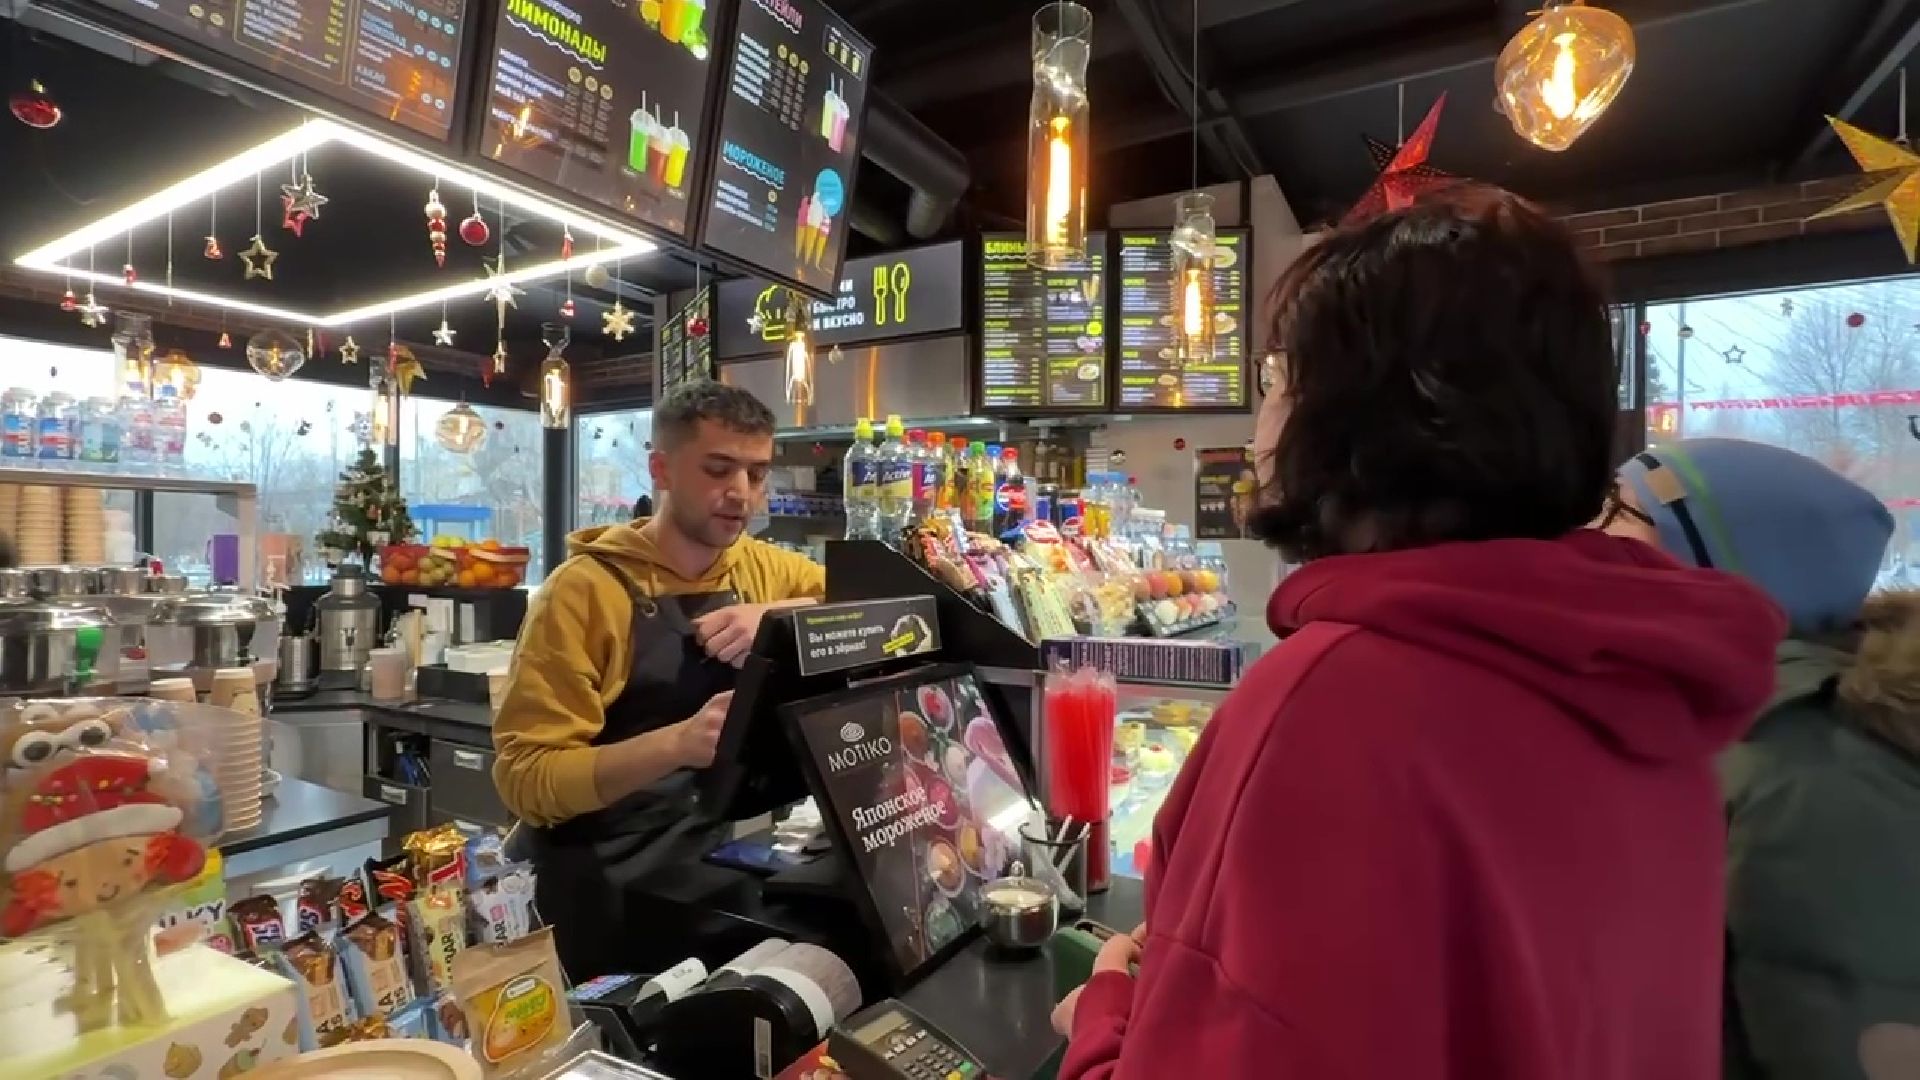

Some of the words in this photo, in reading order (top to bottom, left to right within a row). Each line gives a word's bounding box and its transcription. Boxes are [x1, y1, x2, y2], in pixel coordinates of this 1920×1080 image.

[506, 0, 607, 63] ЛИМОНАДЫ
[723, 139, 785, 185] МОРОЖЕНОЕ
[823, 312, 865, 330] ВКУСНО
[808, 632, 823, 644] Вы
[825, 629, 857, 641] можете
[858, 624, 885, 638] купить
[810, 647, 826, 659] его
[828, 645, 834, 656] в
[828, 737, 892, 773] MOTIKO
[852, 787, 928, 832] Японское
[862, 800, 947, 853] мороженое
